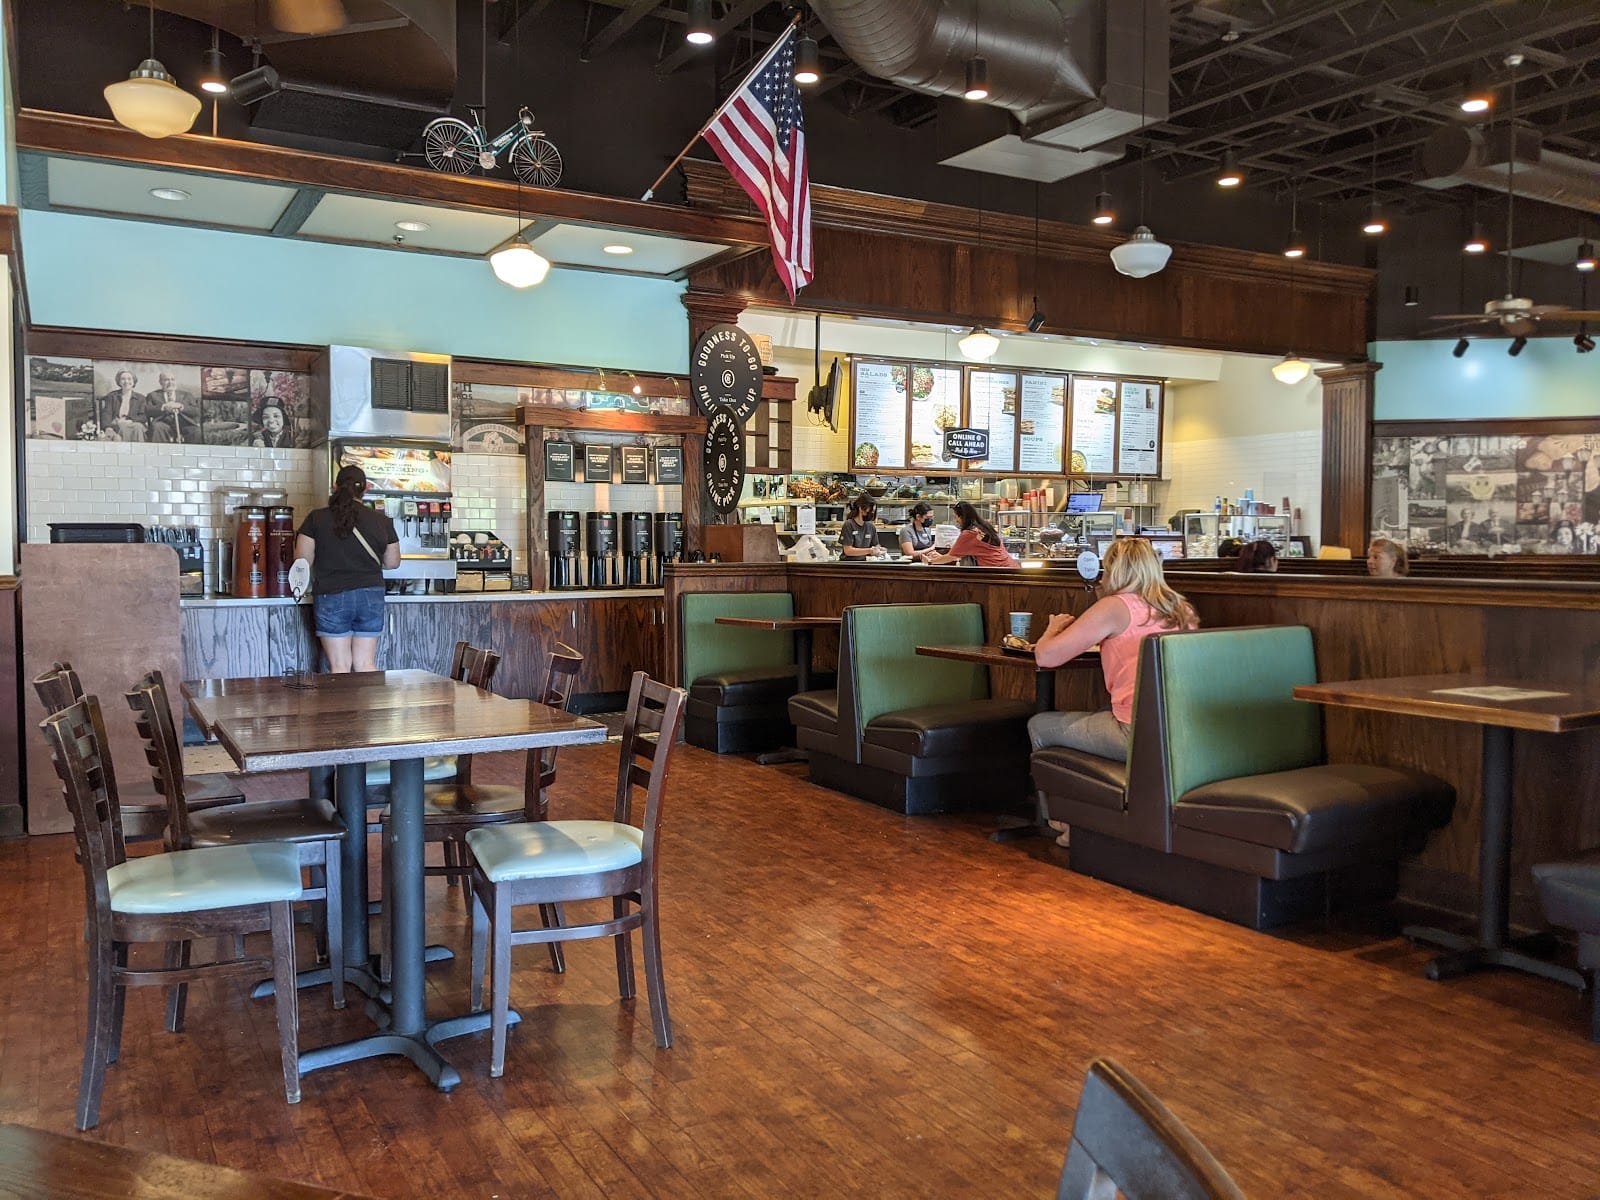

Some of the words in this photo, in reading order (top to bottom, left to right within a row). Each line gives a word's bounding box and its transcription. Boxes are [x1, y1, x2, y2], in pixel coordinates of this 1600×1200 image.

[697, 330, 737, 367] GOODNESS
[739, 338, 758, 371] TO-GO
[698, 385, 718, 414] ONLI
[746, 387, 757, 402] UP
[705, 413, 727, 454] GOODNESS
[727, 418, 740, 451] TO-GO
[947, 439, 963, 447] CALL
[952, 433, 976, 441] ONLINE
[706, 472, 722, 507] ONLINE
[722, 486, 736, 507] PICK
[732, 469, 740, 485] UP
